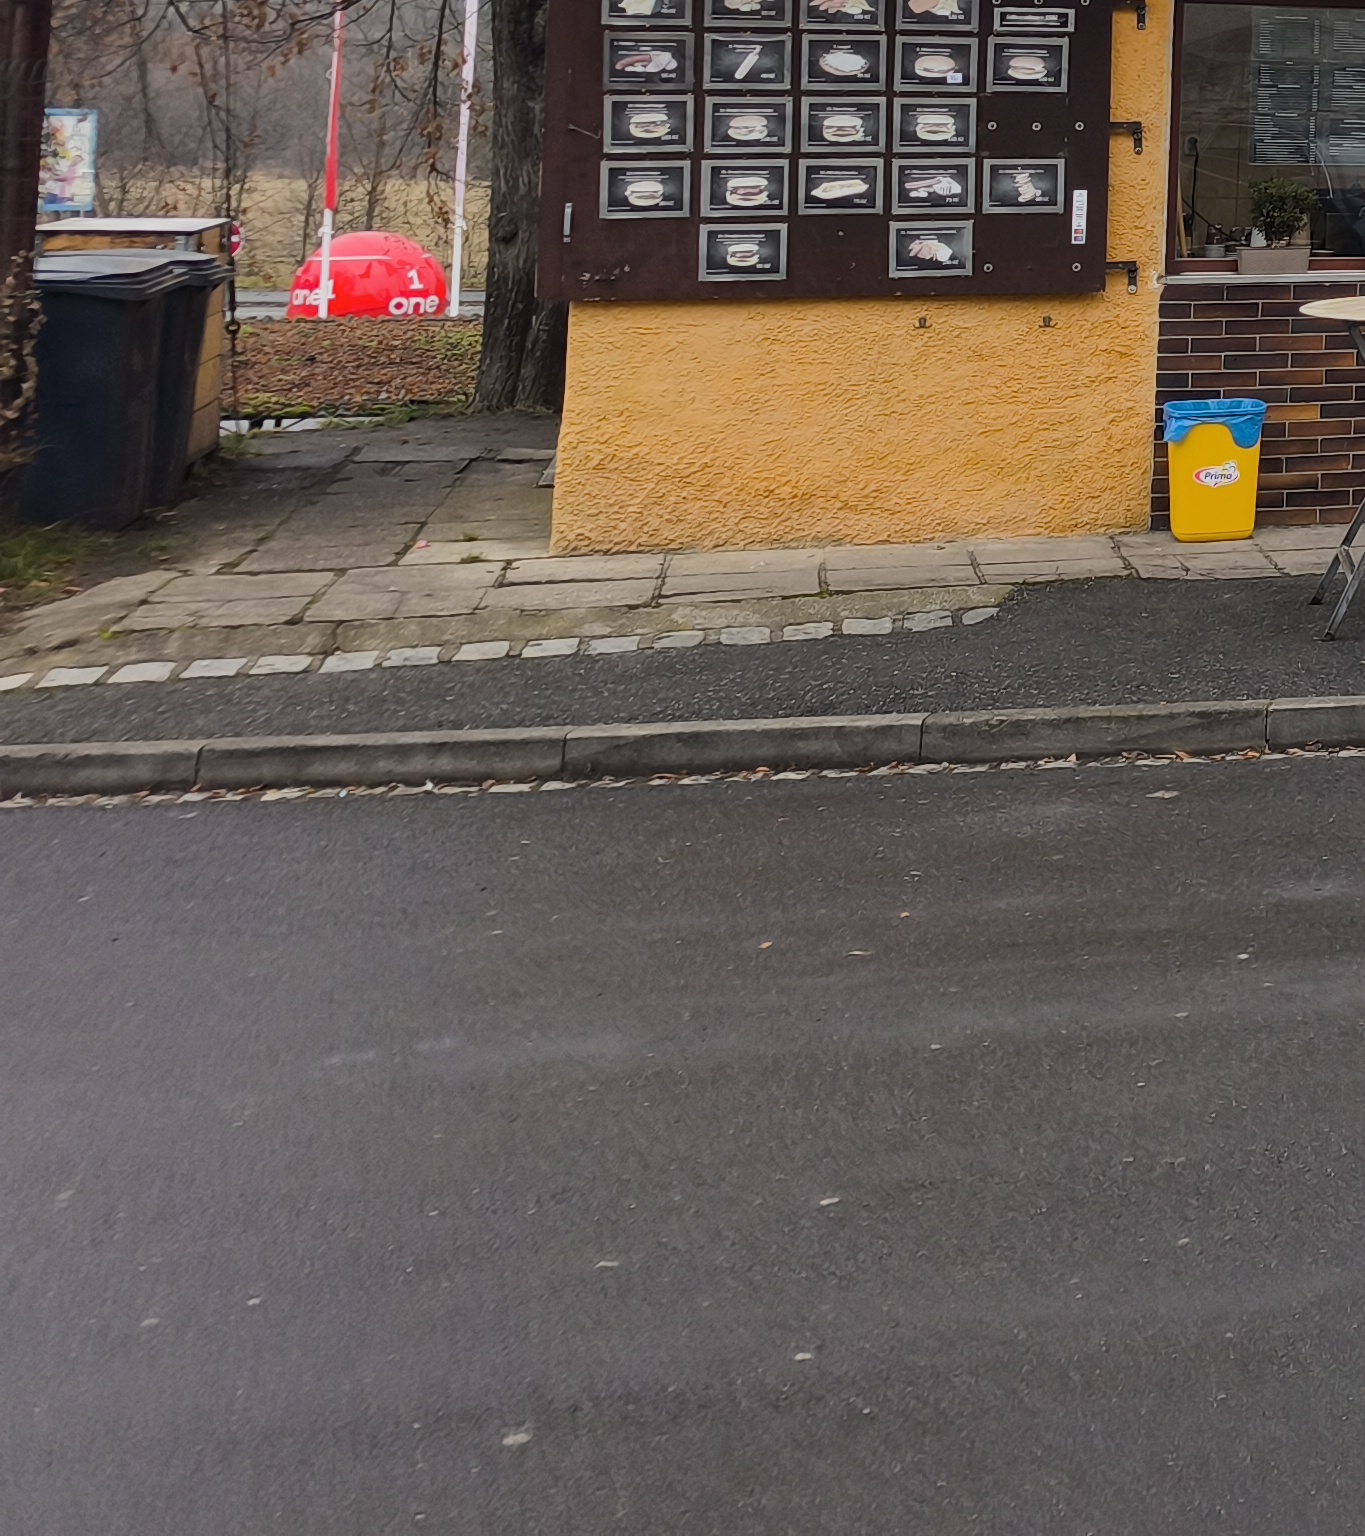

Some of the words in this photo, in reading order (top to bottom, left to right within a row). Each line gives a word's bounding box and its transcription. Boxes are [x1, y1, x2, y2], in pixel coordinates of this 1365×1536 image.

[407, 269, 424, 290] 1
[388, 295, 440, 315] one
[1204, 470, 1233, 482] Prima
